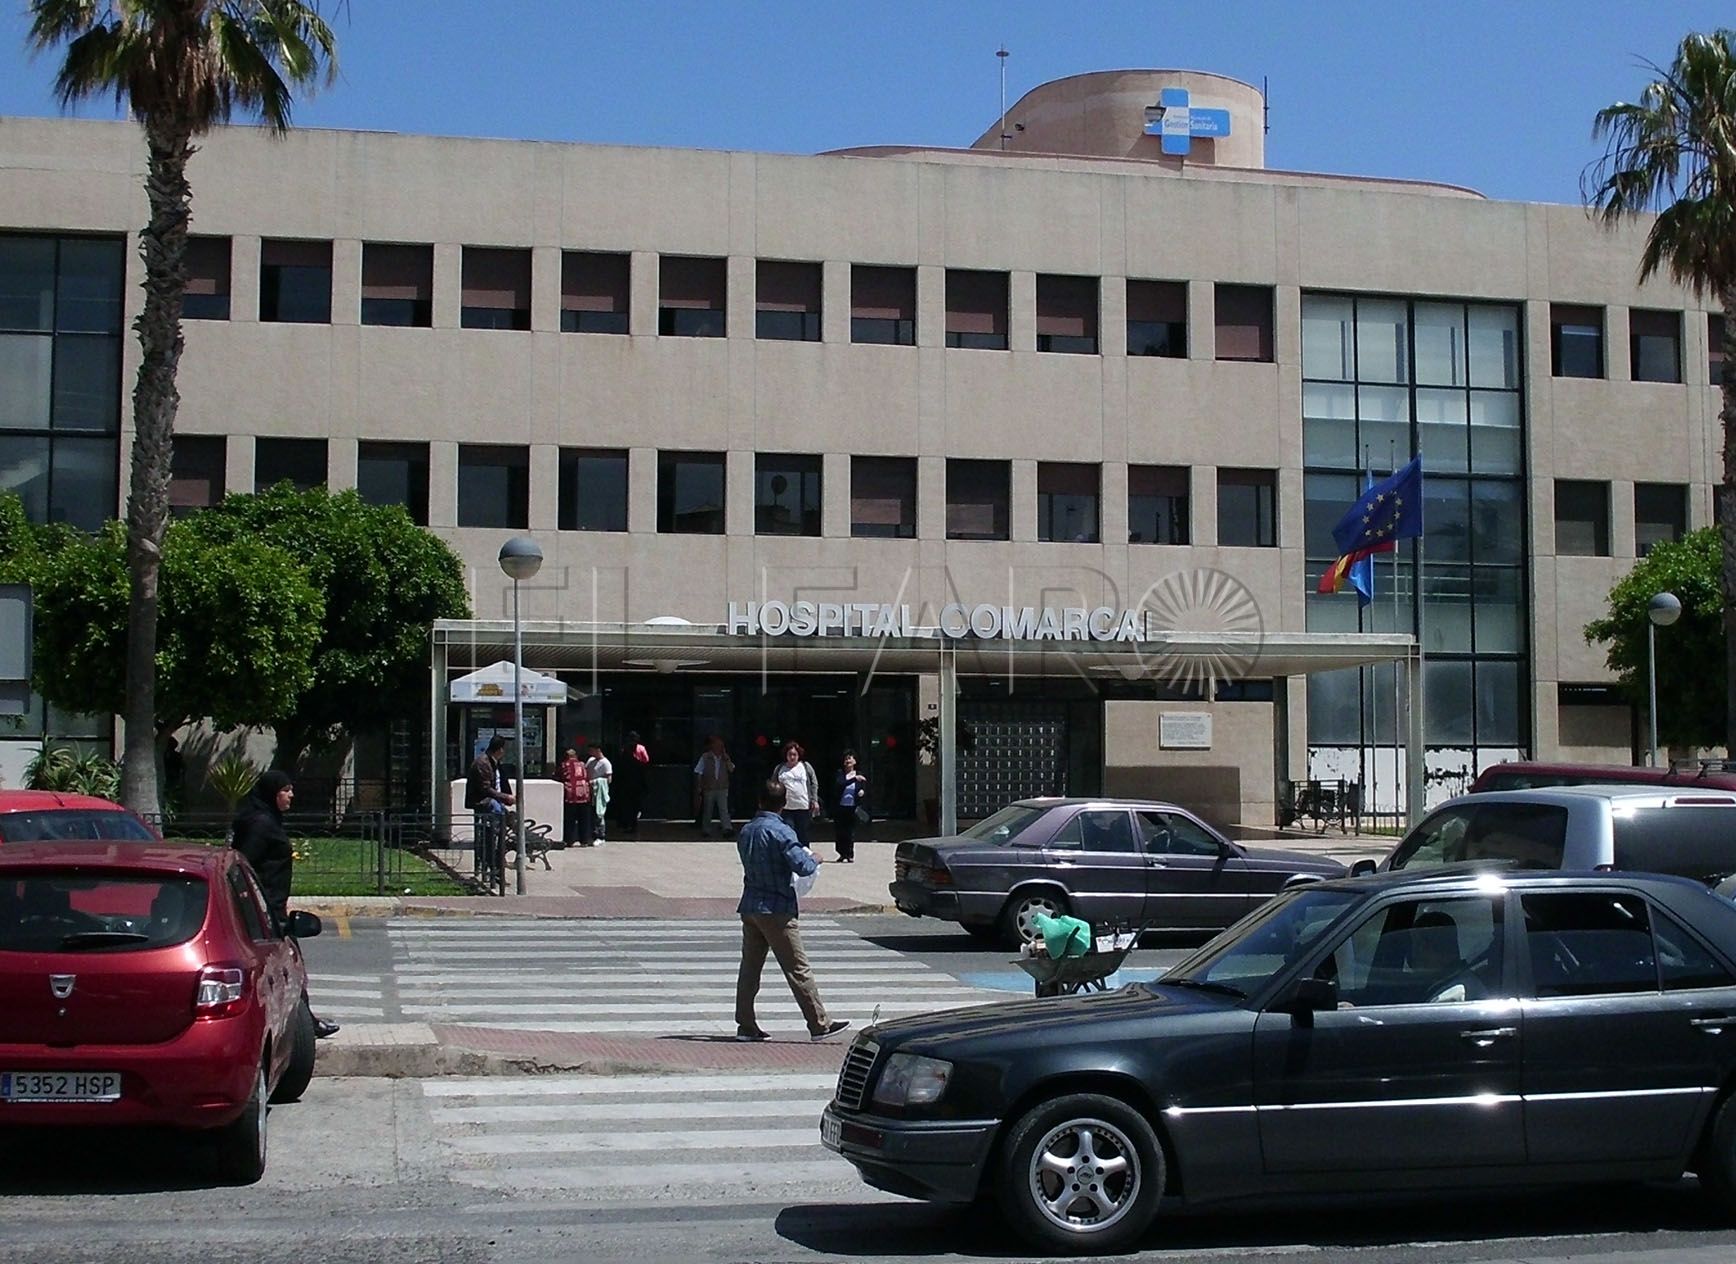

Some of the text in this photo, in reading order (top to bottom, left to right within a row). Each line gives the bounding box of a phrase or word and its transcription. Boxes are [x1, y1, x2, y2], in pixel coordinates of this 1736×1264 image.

[727, 600, 1154, 642] HOSPITAL COMARCAL
[16, 1075, 67, 1095] 5352
[75, 1076, 114, 1095] HSP
